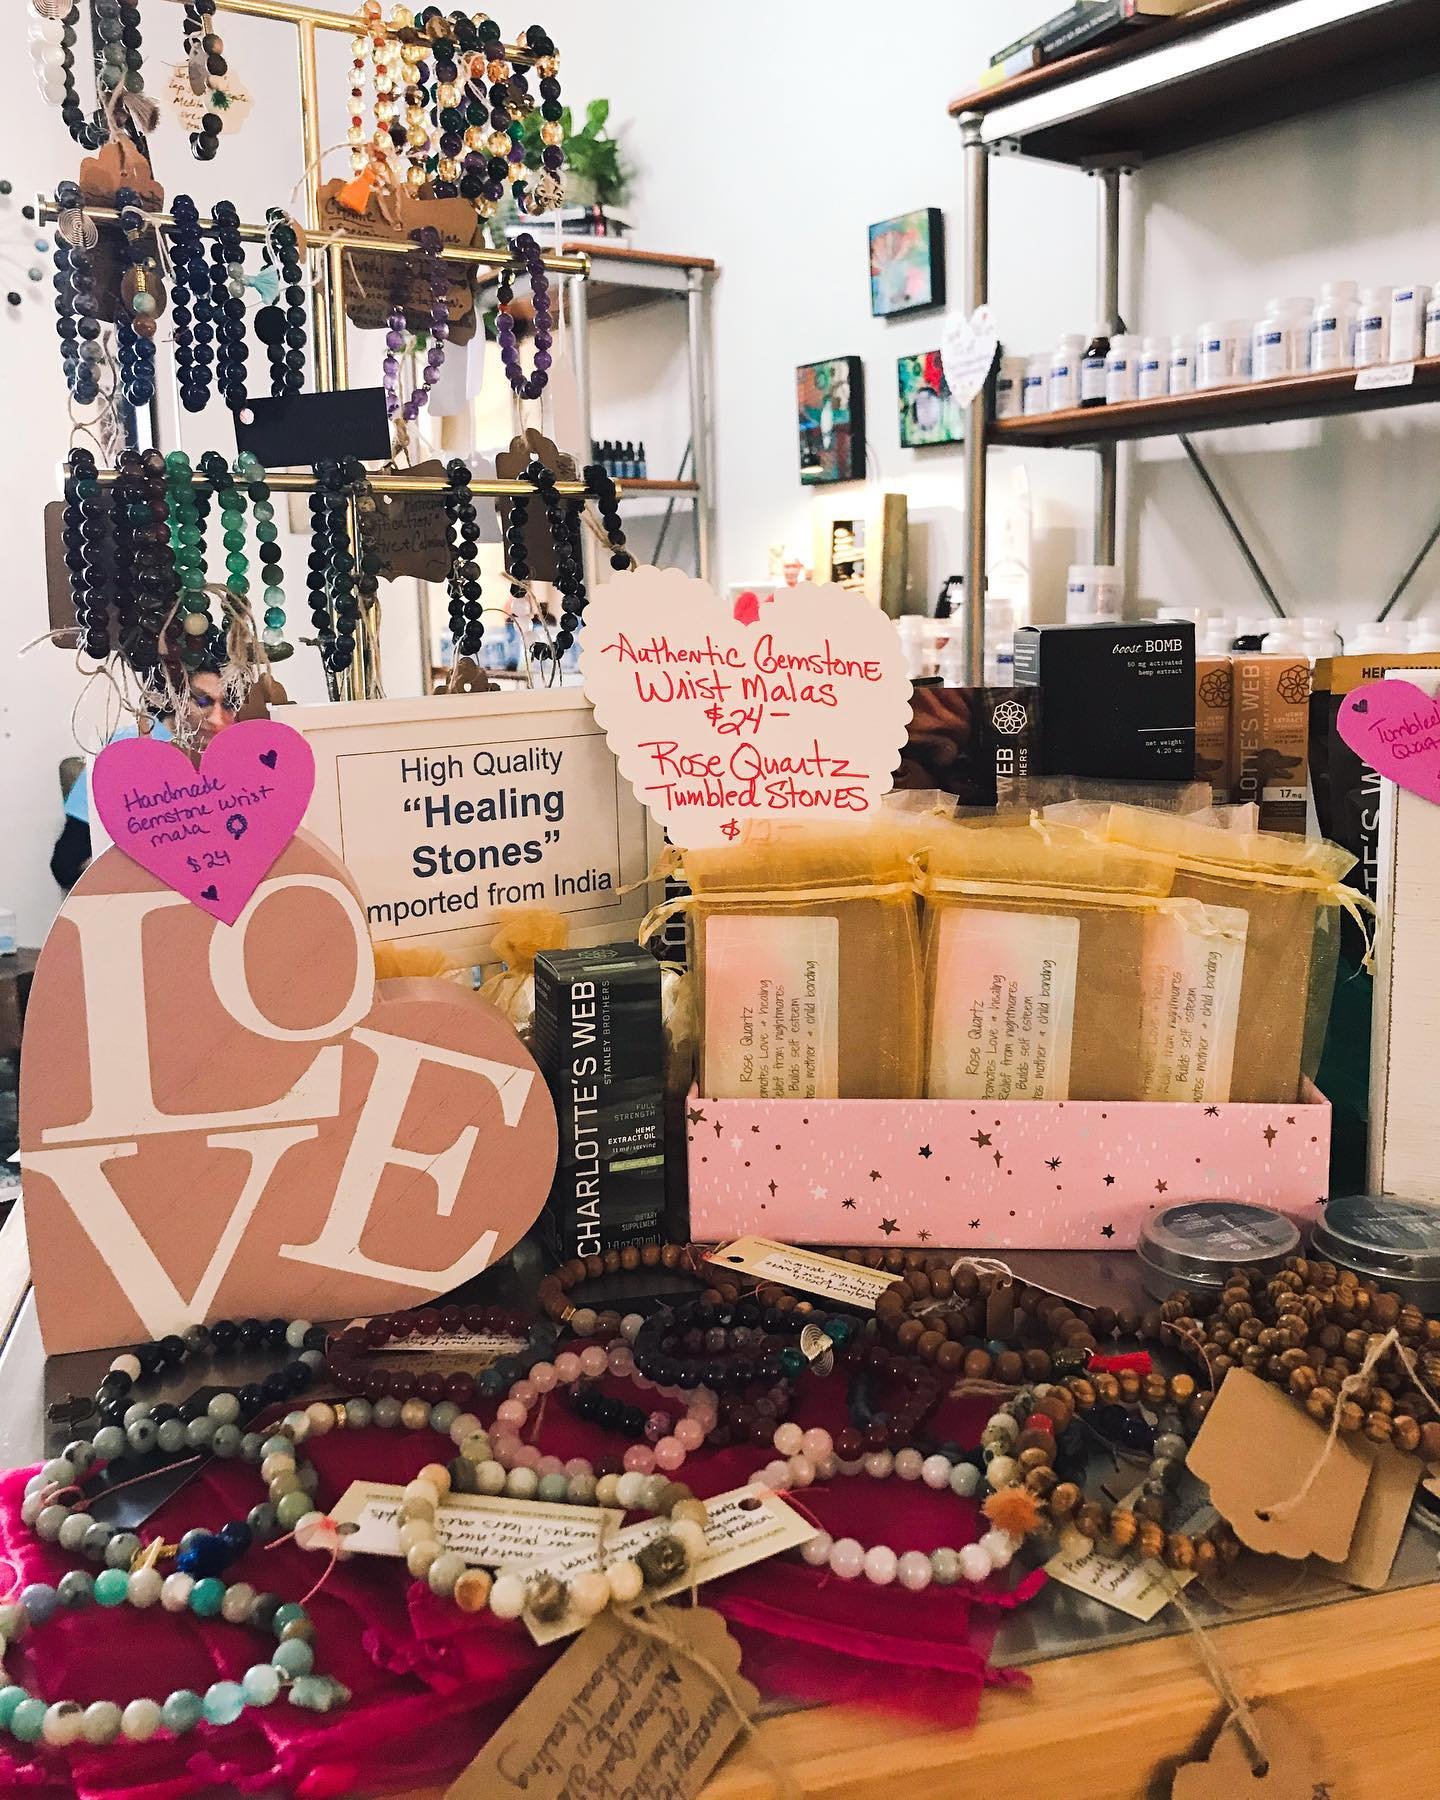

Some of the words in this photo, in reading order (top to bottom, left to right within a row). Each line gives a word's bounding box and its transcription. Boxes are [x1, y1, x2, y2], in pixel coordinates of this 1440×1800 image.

[601, 632, 746, 668] Authentic
[1112, 643, 1143, 654] boost
[1145, 639, 1183, 653] BOMB
[1149, 659, 1183, 667] activated
[635, 669, 731, 702] Wrist
[742, 671, 838, 707] Malas
[1138, 669, 1154, 677] hemp
[1241, 665, 1260, 711] WEB
[401, 754, 463, 787] High
[473, 747, 563, 776] Quality
[638, 741, 725, 778] Rose
[730, 741, 870, 781] Quartz
[996, 748, 1014, 794] WEB
[1239, 717, 1259, 802] LOTTE'S
[124, 775, 225, 812] Handmade
[403, 787, 565, 828] “Healing
[645, 779, 762, 810] Tumbled
[127, 804, 213, 835] Gemstone
[412, 829, 560, 878] Stones”
[367, 885, 479, 927] mported
[487, 881, 545, 906] from
[554, 869, 612, 897] India
[804, 960, 820, 998] bonding
[1040, 959, 1056, 997] bonding
[1204, 951, 1223, 989] bonding
[602, 980, 611, 1035] BROTHERS
[758, 979, 774, 1012] healing
[990, 975, 1006, 1010] healing
[1003, 981, 1019, 1037] nightmares
[1168, 971, 1183, 1029] nightmares
[1185, 987, 1197, 1023] esteem
[1200, 993, 1212, 1016] child
[571, 981, 597, 1049] WEB
[740, 1007, 754, 1047] Quartz
[774, 985, 787, 1041] nightmares
[791, 997, 800, 1033] esteem
[804, 1002, 816, 1024] child
[968, 1000, 984, 1040] Quartz
[1021, 996, 1033, 1032] esteem
[1037, 1002, 1048, 1024] child
[759, 1033, 769, 1059] Love
[789, 1039, 800, 1058] self
[985, 1029, 999, 1054] Love
[1001, 1043, 1013, 1066] from
[1018, 1038, 1030, 1056] self
[1180, 1028, 1193, 1049] self
[1195, 1037, 1209, 1072] mother
[603, 1040, 612, 1085] STANLEY
[740, 1054, 754, 1083] Rose
[772, 1046, 785, 1069] from
[804, 1046, 816, 1079] mother
[966, 1046, 981, 1075] Rose
[1033, 1045, 1046, 1079] mother
[1175, 1054, 1190, 1083] Builds
[758, 1064, 769, 1099] omotes
[788, 1063, 800, 1092] Builds
[1016, 1062, 1029, 1090] Builds
[614, 1110, 656, 1122] STRENGTH
[635, 1126, 656, 1134] HEMP
[608, 1134, 642, 1145] EXTRACT
[644, 1132, 656, 1141] OIL
[571, 1056, 600, 1258] CHARLOTTE'S
[622, 1219, 657, 1231] SUPPLEMENT
